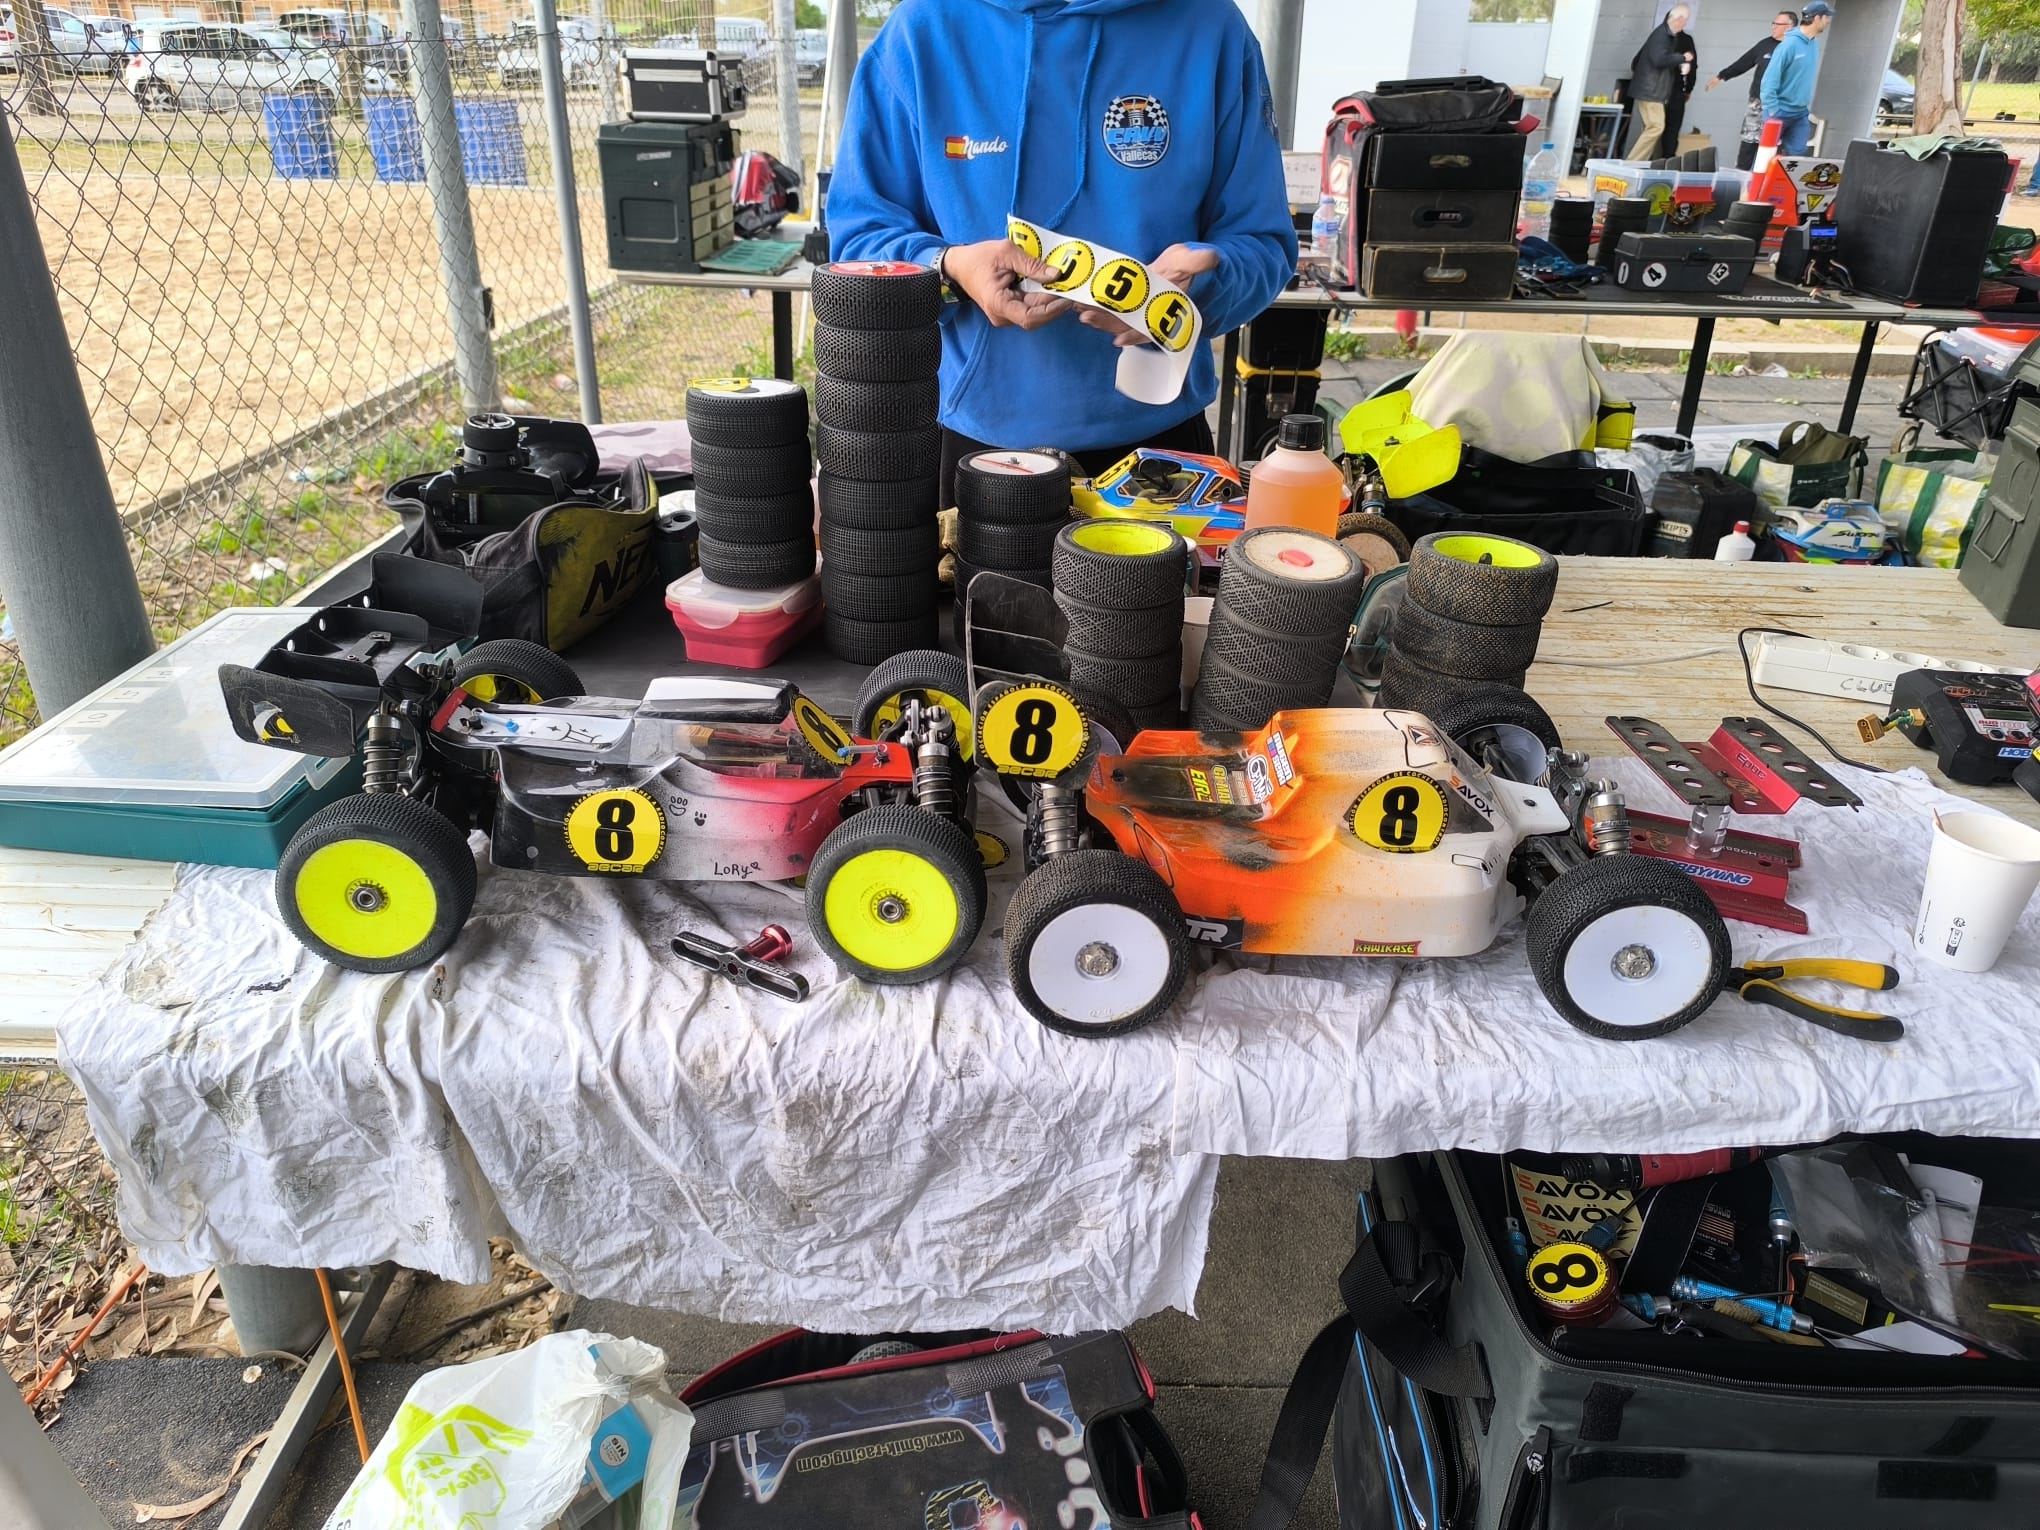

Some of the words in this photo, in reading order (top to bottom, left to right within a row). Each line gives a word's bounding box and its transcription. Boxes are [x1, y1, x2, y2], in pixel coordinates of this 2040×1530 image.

[962, 135, 1009, 160] Nando
[1120, 150, 1159, 162] Vallecas
[1104, 264, 1138, 301] 5
[1158, 298, 1188, 339] 5
[802, 706, 846, 753] 8
[1010, 698, 1057, 764] 8
[595, 798, 636, 861] 8
[1379, 786, 1420, 847] 8
[1665, 860, 1753, 886] OBBYWING
[1355, 942, 1416, 954] KAWIKASE
[1531, 1252, 1599, 1294] 8
[796, 1428, 966, 1473] www.6mik-racing.com
